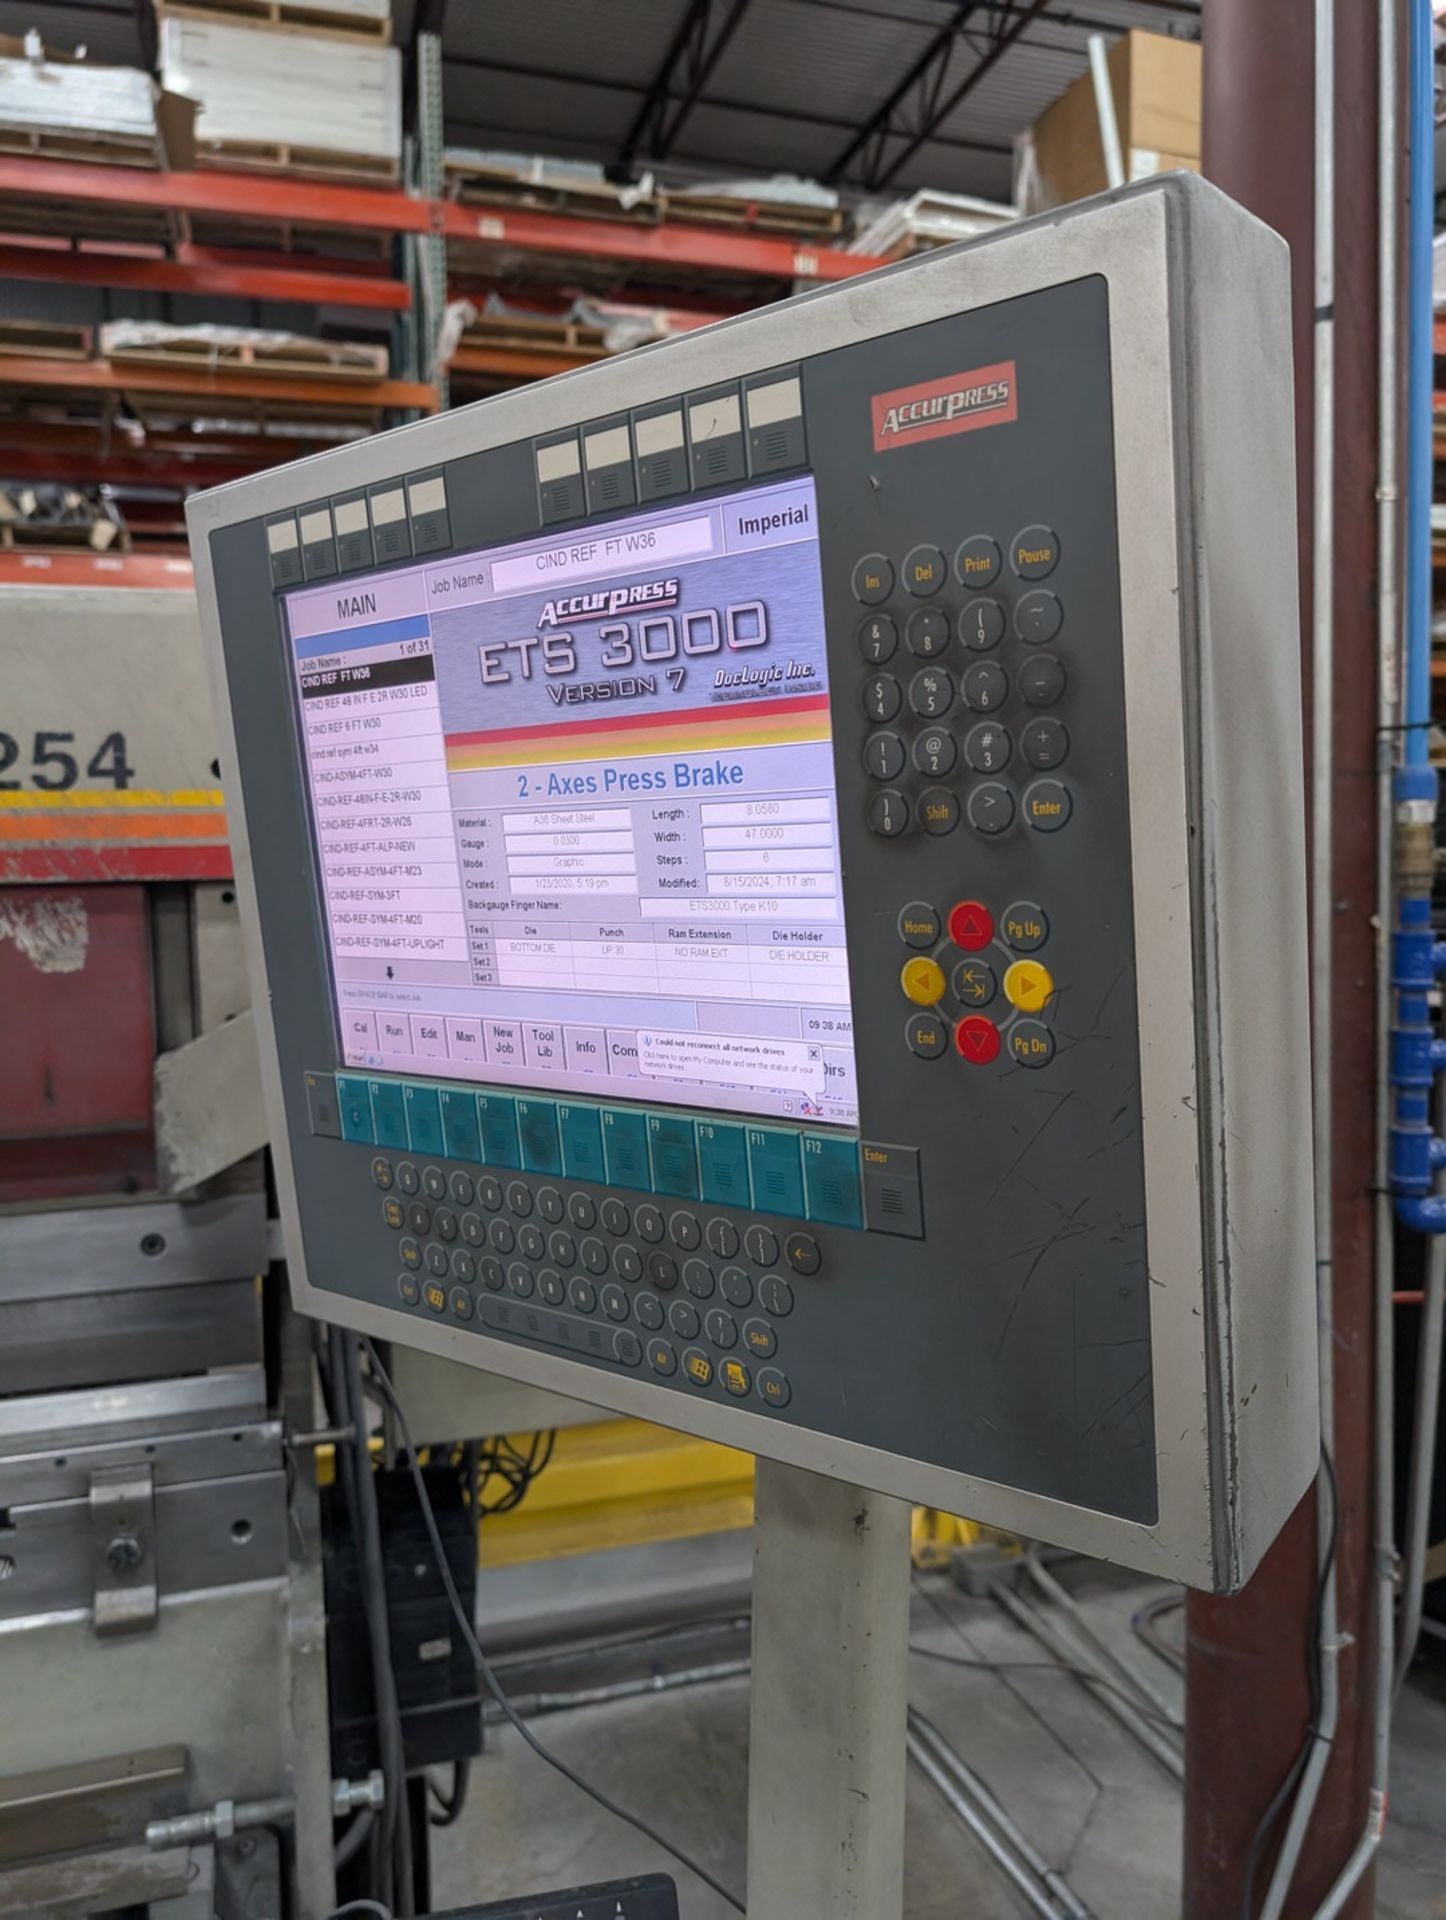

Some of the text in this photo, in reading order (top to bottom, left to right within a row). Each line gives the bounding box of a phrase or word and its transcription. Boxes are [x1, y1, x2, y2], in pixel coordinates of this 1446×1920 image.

[739, 504, 810, 536] Imperial
[536, 531, 657, 571] CIND REF FT W36
[1018, 548, 1051, 564] Pause
[965, 557, 991, 572] Print
[915, 564, 933, 580] Del
[431, 576, 450, 594] Job
[866, 575, 880, 589] Ins
[337, 593, 377, 620] MAIN
[478, 600, 768, 684] ETS 3000
[924, 636, 931, 650] 8
[978, 630, 985, 644] 9
[400, 640, 430, 655] 1 of 31
[873, 642, 880, 656] 7
[302, 659, 317, 672] Job
[787, 659, 816, 678] Inc.
[302, 667, 372, 688] CIND REF FT W36
[666, 667, 686, 693] 7
[928, 697, 935, 711] 5
[981, 691, 989, 706] 6
[877, 701, 884, 716] 4
[930, 756, 938, 771] 2
[984, 752, 992, 767] 3
[518, 775, 529, 797] 2
[548, 772, 597, 796] Axes
[603, 768, 667, 792] Press
[674, 760, 744, 787] Brake
[652, 809, 685, 821] Length
[1032, 801, 1061, 816] Enter
[745, 827, 784, 839] 47.0000
[553, 857, 584, 869] Graphic
[468, 900, 509, 912] Backgauge
[511, 900, 536, 912] Finger
[689, 901, 778, 913] ETS3000 Type K10
[524, 926, 537, 935] Die
[599, 927, 625, 937] Punch
[905, 920, 933, 933] Home
[1008, 922, 1041, 937] Pg Up
[668, 929, 732, 940] Ram Extension
[772, 931, 823, 941] Die Holder
[675, 947, 728, 959] NO RAM EXT
[769, 951, 830, 962] DIE HOLDER
[354, 1022, 368, 1033] Cal
[386, 1024, 403, 1036] Run
[421, 1028, 438, 1040] Edit
[493, 1026, 513, 1038] New
[456, 1030, 476, 1043] Man
[532, 1029, 554, 1042] Tool
[917, 1030, 935, 1044] End
[495, 1042, 514, 1055] Job
[537, 1046, 553, 1058] Lib
[576, 1041, 596, 1053] Info
[1015, 1038, 1046, 1054] Pg Dn
[751, 1132, 765, 1145] F11
[806, 1140, 822, 1153] F12
[865, 1148, 888, 1163] Enter
[751, 1332, 769, 1347] Shift
